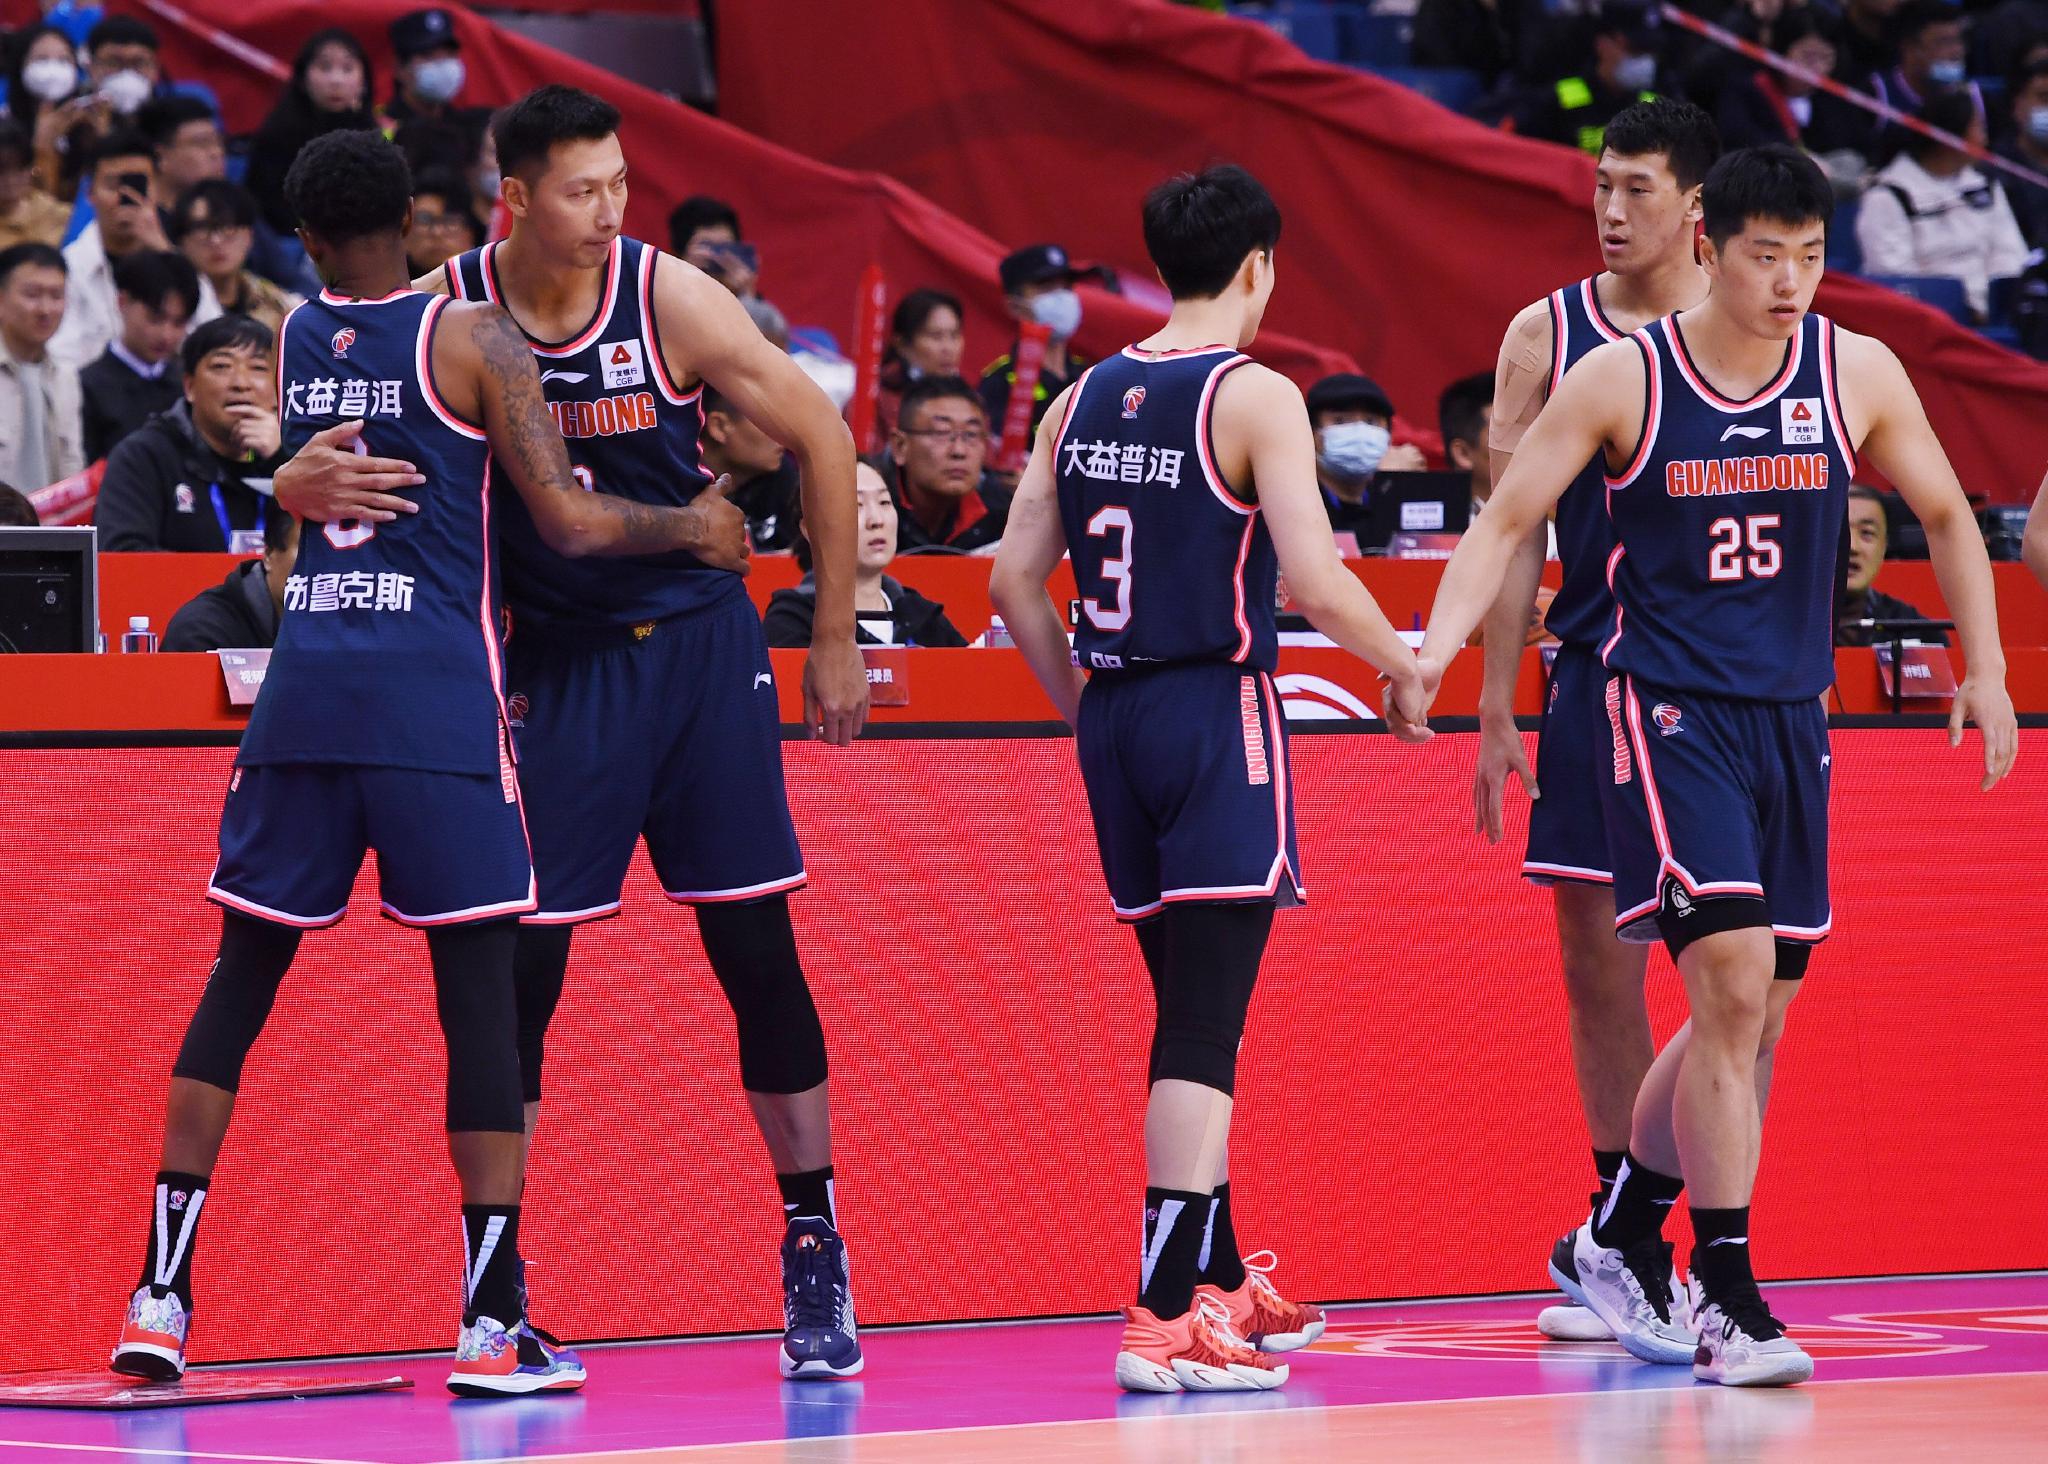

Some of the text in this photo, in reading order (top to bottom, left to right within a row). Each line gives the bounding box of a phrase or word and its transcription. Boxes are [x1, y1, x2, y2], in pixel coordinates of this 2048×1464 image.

[284, 377, 403, 420] 大益普洱
[615, 377, 633, 386] CGB
[1793, 434, 1812, 443] CGB
[1064, 438, 1185, 489] 大益普洱
[1666, 453, 1829, 497] GUANGDONG
[1082, 504, 1134, 632] 3
[1709, 514, 1783, 581] 25
[284, 571, 415, 612] 布鲁克斯
